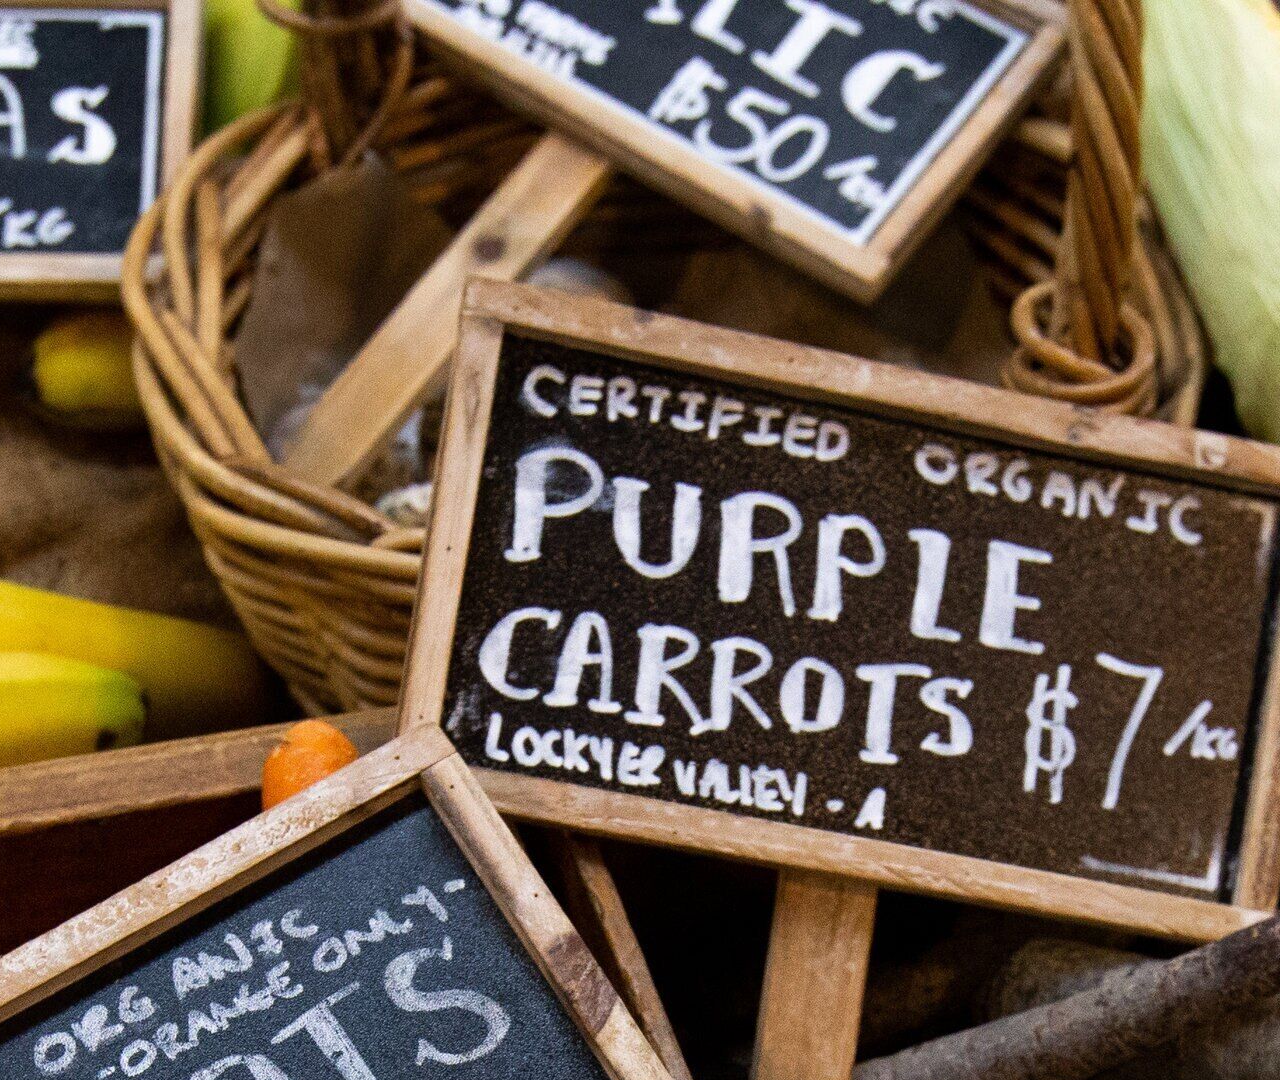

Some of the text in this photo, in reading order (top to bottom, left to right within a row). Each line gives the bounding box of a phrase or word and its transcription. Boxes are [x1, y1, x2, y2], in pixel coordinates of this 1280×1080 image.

[523, 364, 1204, 546] CERTIFIED ORGANIC
[503, 446, 1053, 655] PURPLE
[478, 606, 975, 765] CARROTS
[485, 712, 667, 786] LOCKYER
